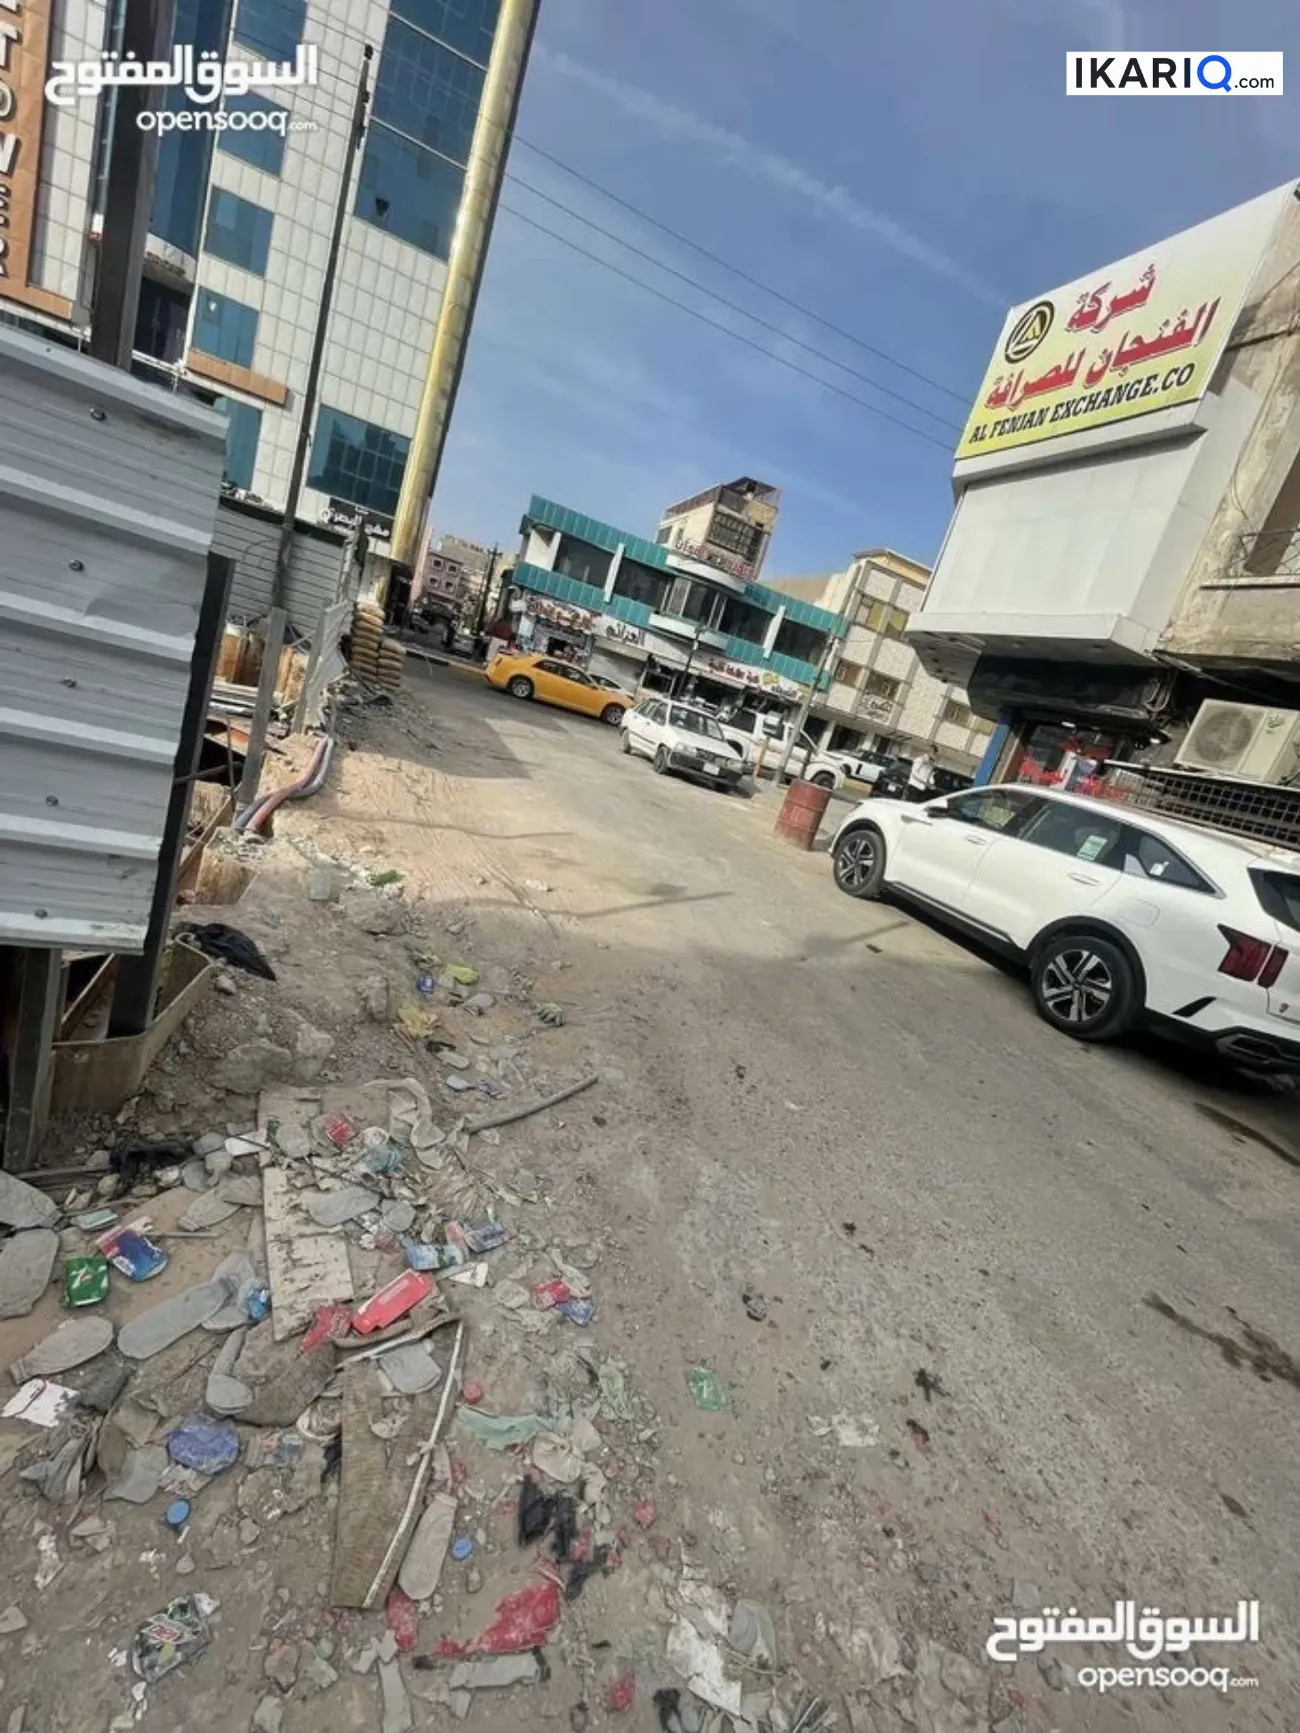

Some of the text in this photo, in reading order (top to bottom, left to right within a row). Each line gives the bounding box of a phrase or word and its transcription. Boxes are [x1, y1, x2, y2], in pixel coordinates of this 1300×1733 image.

[1065, 263, 1156, 333] شركة
[985, 296, 1221, 411] الفنجان للصرافة
[968, 424, 987, 443] AL
